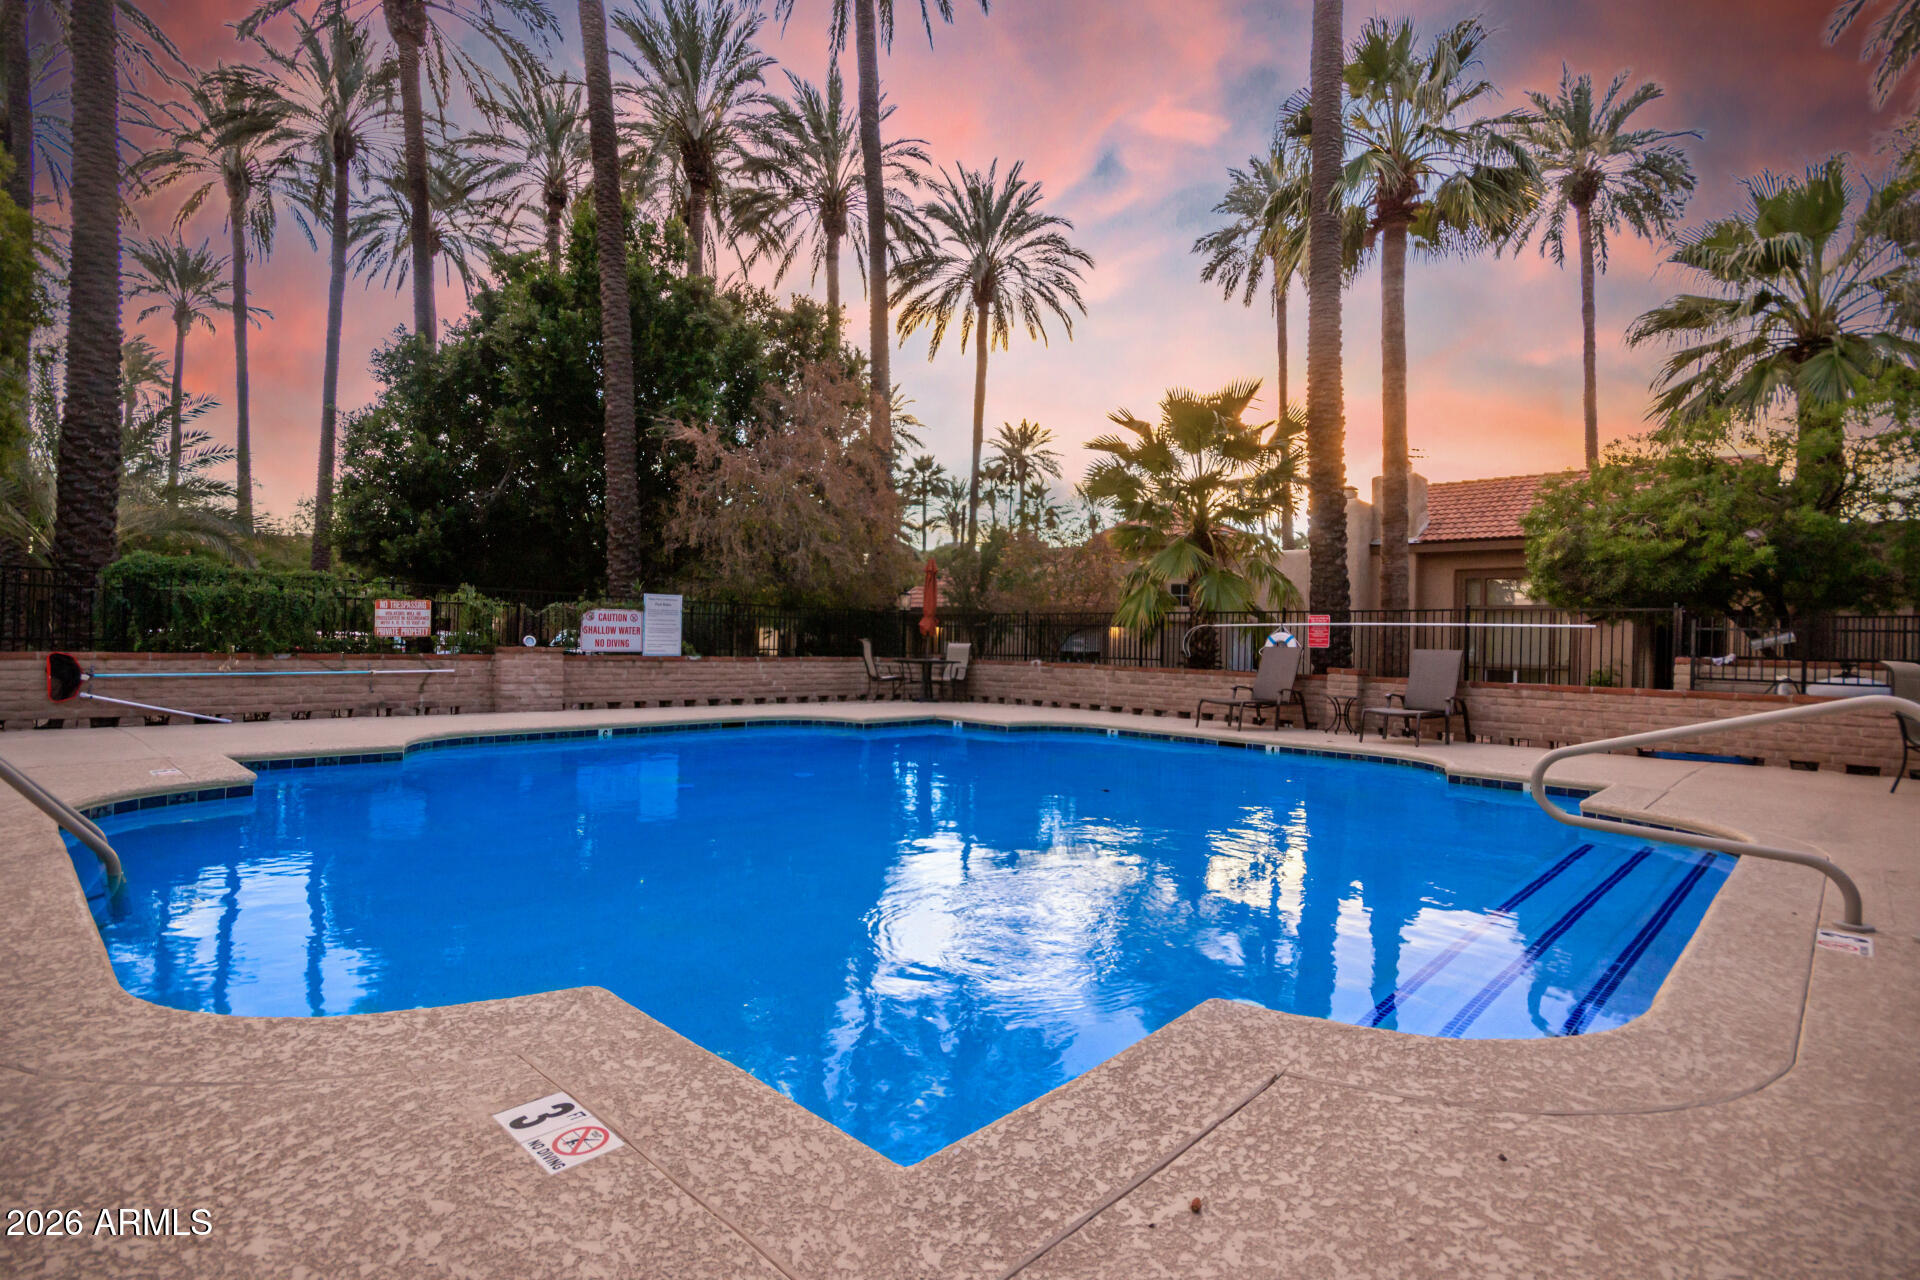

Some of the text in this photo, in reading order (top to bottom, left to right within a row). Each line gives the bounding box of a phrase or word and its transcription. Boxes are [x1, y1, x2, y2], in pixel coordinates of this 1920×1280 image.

[380, 600, 427, 609] NO TRESPASSING
[598, 613, 627, 622] CAUTION
[376, 627, 429, 636] PRIVATE PROPERTY
[583, 626, 616, 635] SHALLOW
[618, 626, 640, 635] WATER
[594, 639, 630, 648] NO DIVING
[509, 1102, 575, 1130] 3
[528, 1139, 566, 1170] NO DIVING
